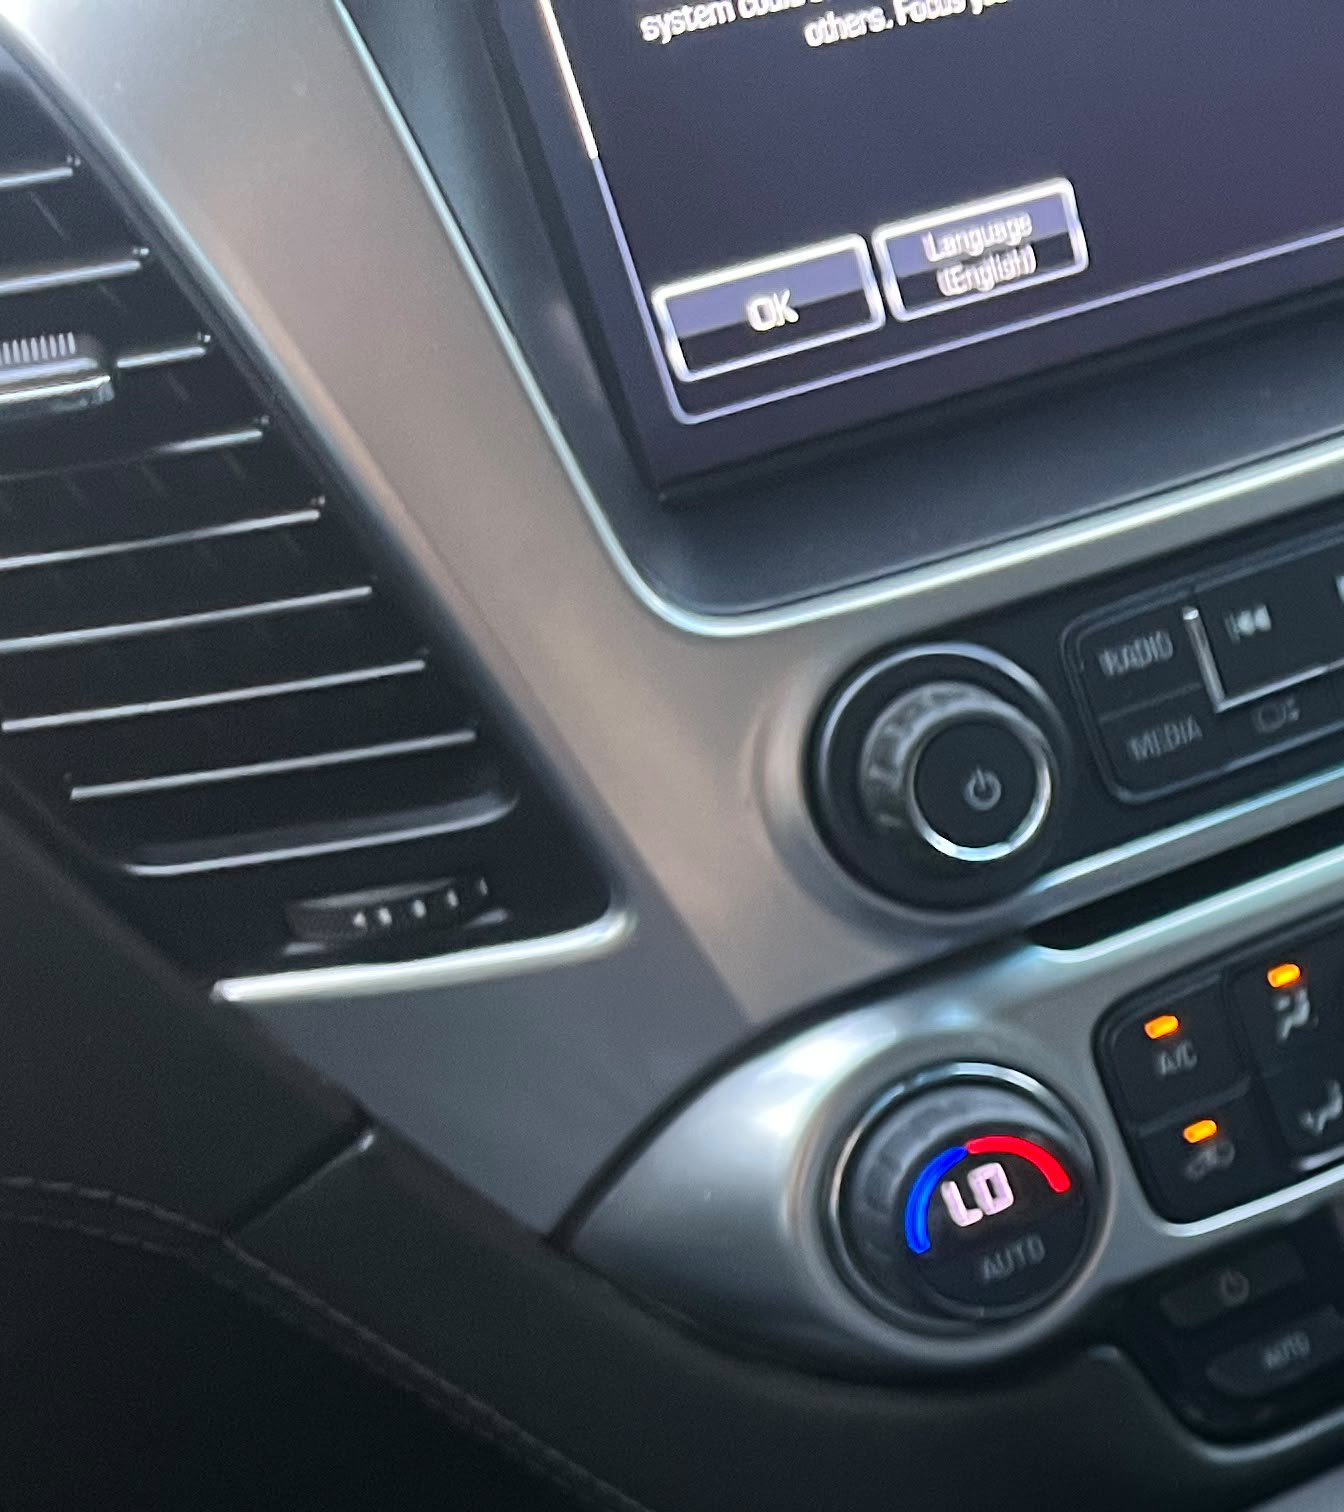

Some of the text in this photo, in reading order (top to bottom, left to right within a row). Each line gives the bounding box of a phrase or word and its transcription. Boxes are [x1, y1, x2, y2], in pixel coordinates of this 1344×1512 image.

[639, 1, 737, 44] system
[803, 6, 894, 47] others.
[920, 212, 1033, 262] Language
[934, 243, 1038, 297] (English)
[746, 288, 800, 332] OK
[1097, 631, 1174, 676] RADIO
[1124, 715, 1202, 761] MEDIA
[1154, 1039, 1198, 1075] A/C
[940, 1162, 1014, 1228] LO
[977, 1233, 1046, 1280] AUTO
